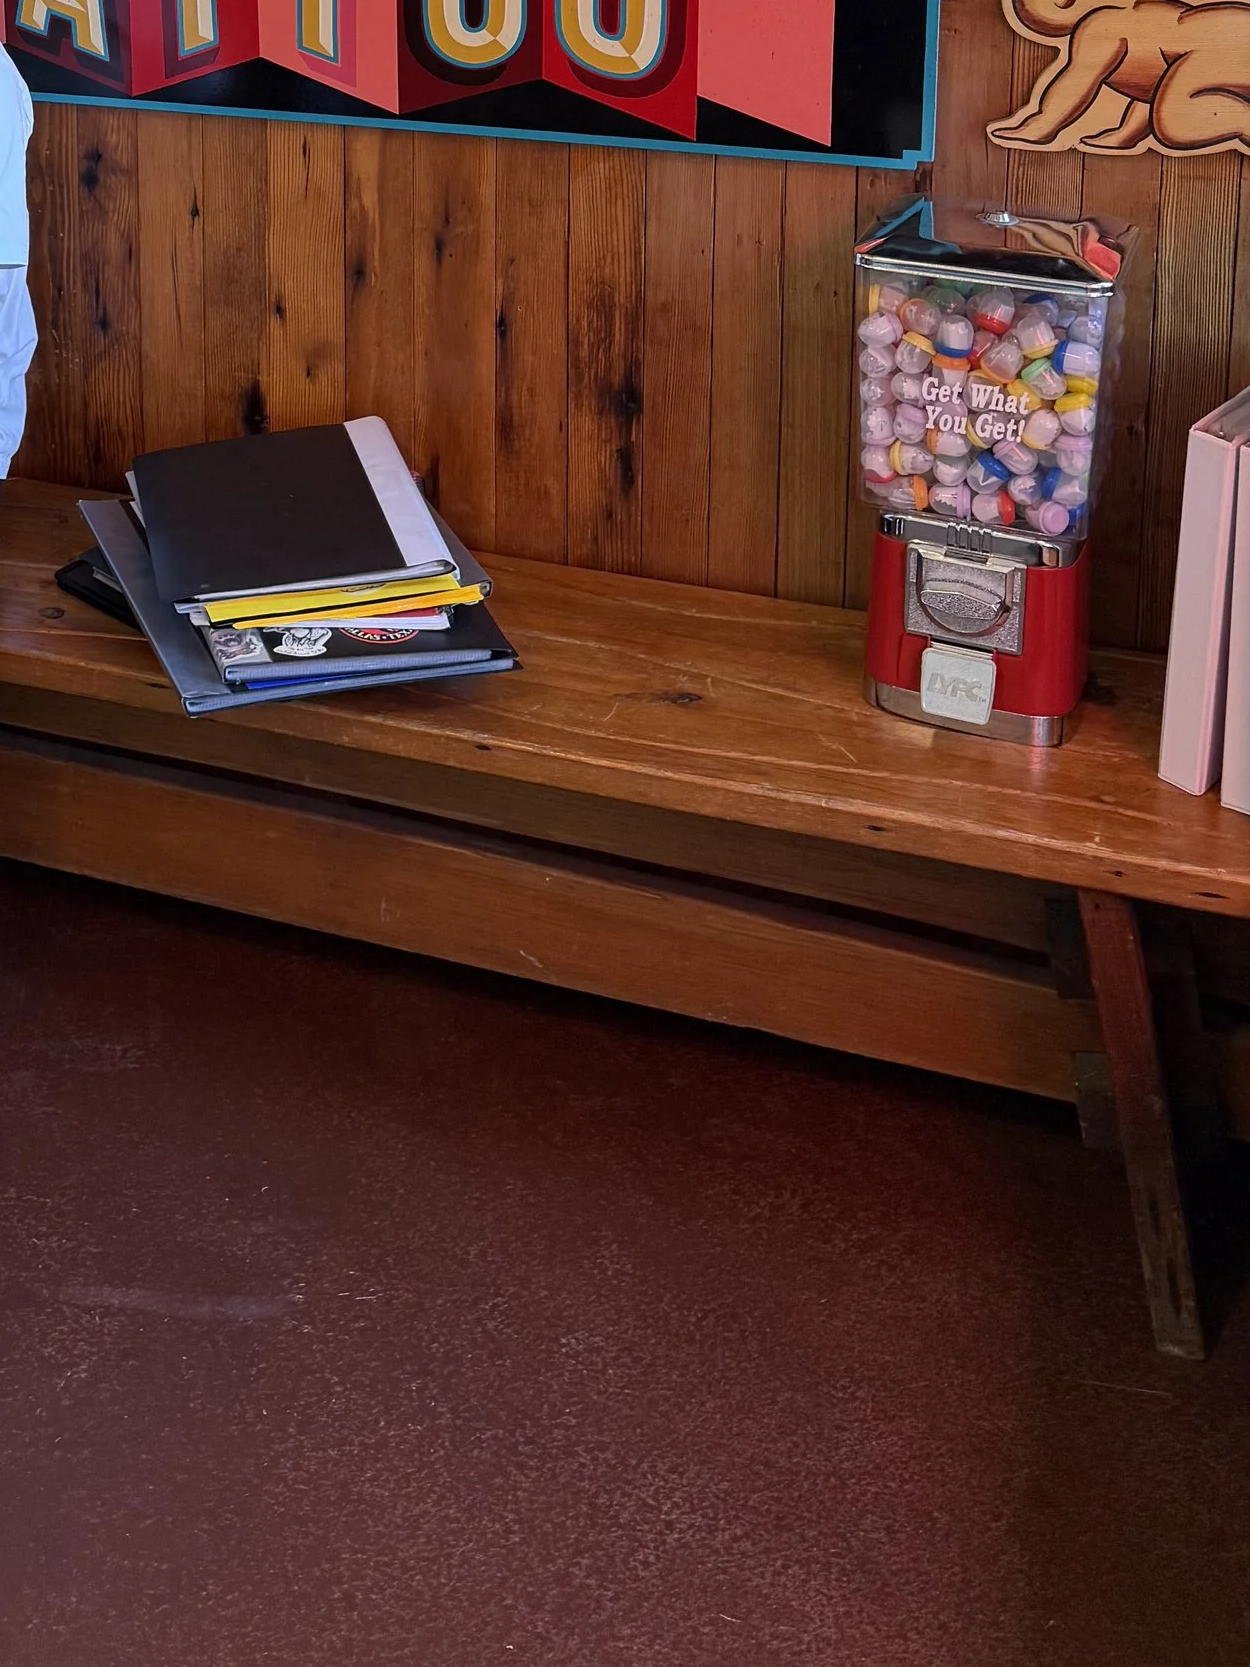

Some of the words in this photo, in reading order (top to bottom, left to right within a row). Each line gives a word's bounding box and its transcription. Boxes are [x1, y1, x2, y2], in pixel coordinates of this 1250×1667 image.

[921, 376, 963, 405] Get
[971, 382, 1030, 415] What
[925, 405, 968, 435] You
[975, 413, 1026, 444] Get!
